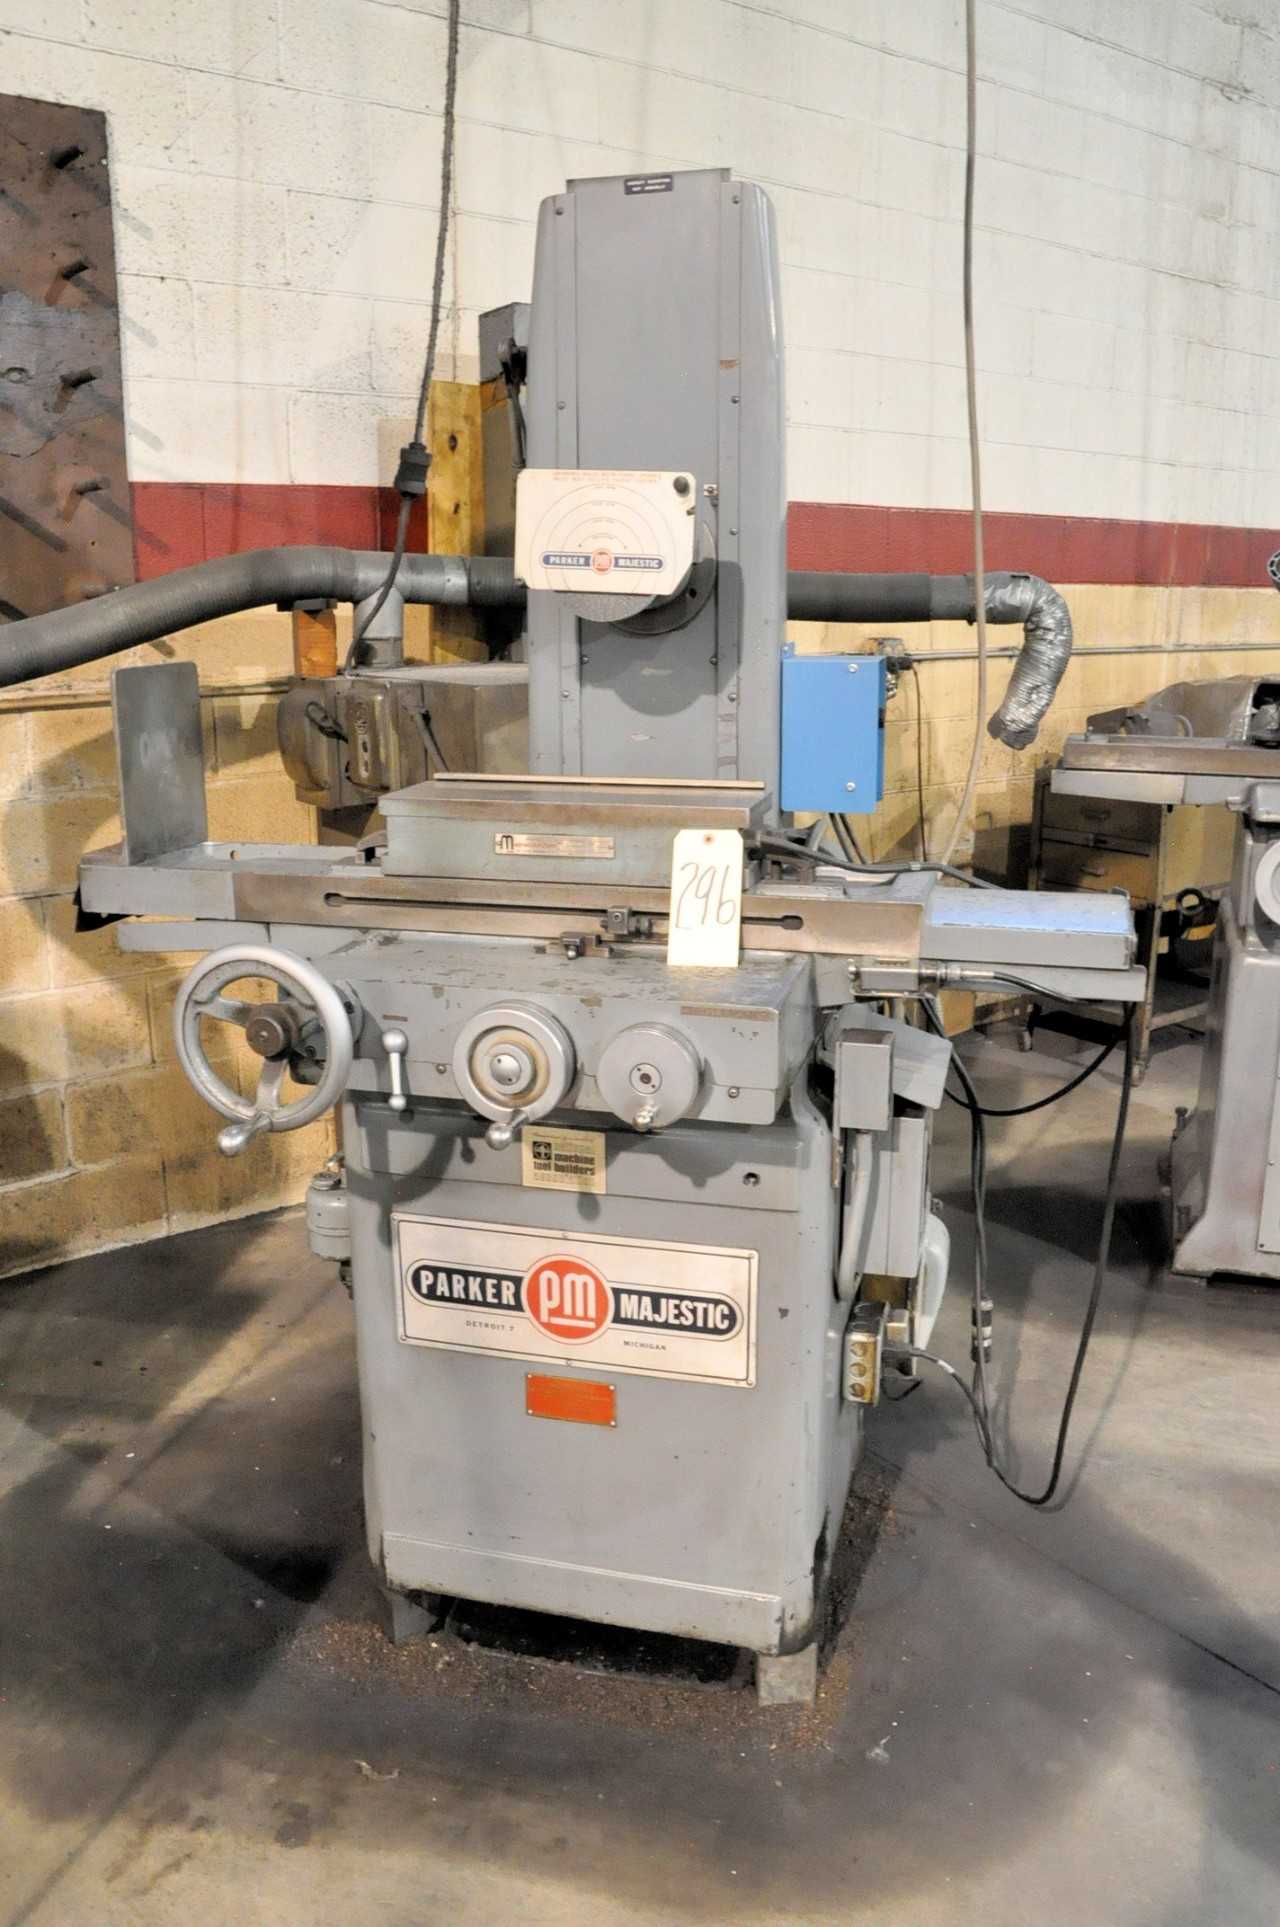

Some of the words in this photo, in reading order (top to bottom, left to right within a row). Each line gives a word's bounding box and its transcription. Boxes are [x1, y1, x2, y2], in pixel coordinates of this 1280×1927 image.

[549, 555, 586, 566] PARKER
[618, 558, 660, 569] MAJESTIC
[553, 1163, 596, 1176] builders
[420, 1269, 517, 1306] PARKER
[619, 1293, 731, 1330] MAJESTIC
[465, 1319, 506, 1331] DETROIT
[622, 1339, 668, 1351] MICHIGAN
